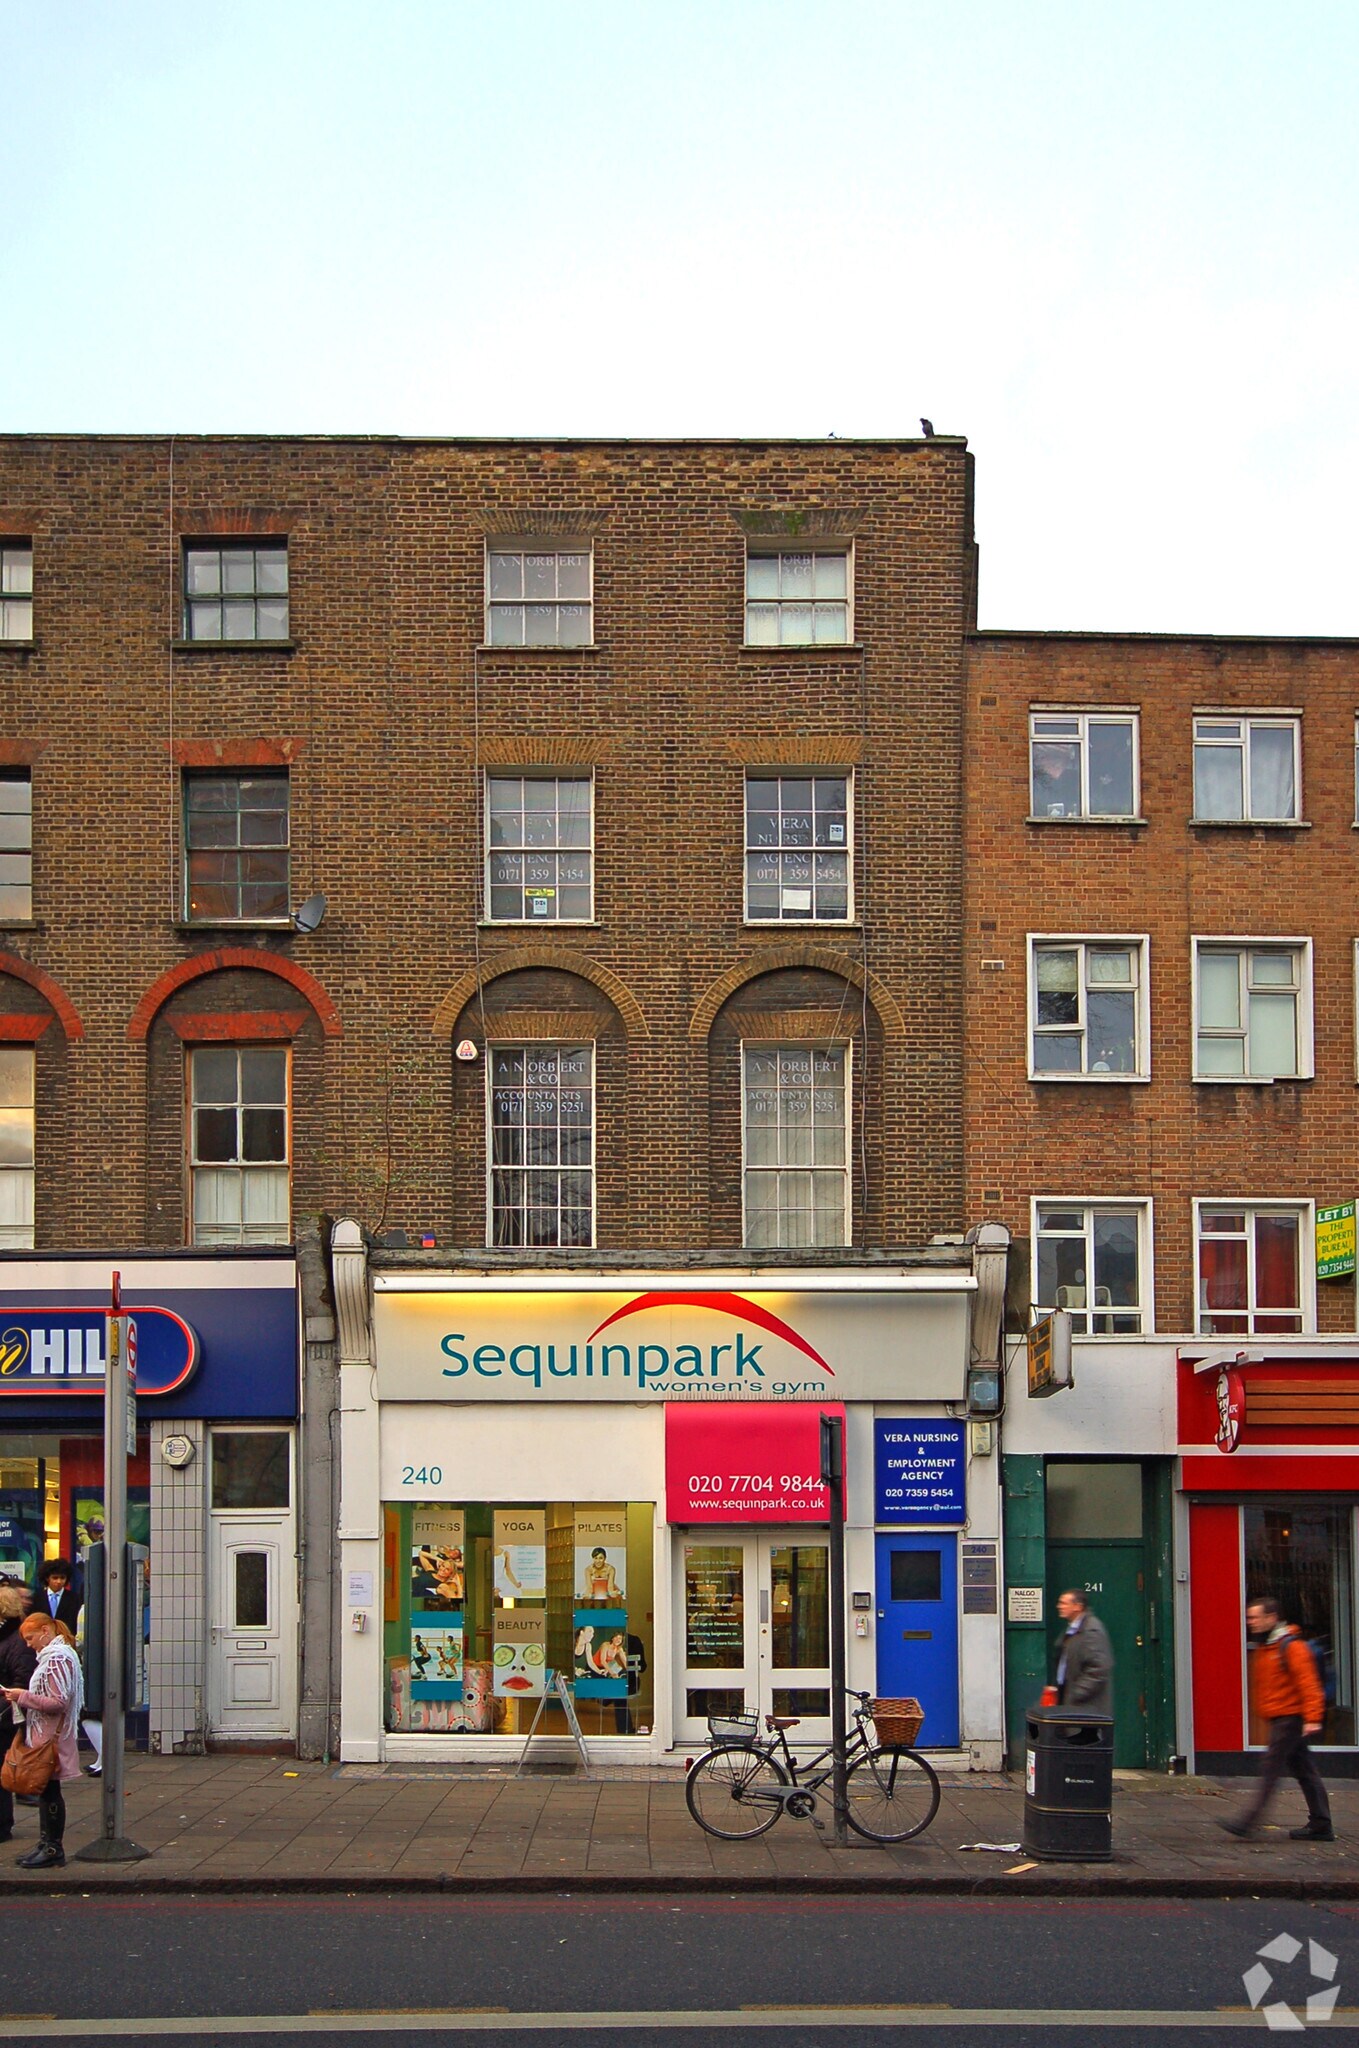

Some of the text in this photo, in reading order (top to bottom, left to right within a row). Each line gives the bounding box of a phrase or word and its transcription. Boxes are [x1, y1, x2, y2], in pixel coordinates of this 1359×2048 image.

[512, 556, 584, 566] NORBERT
[770, 818, 810, 829] VERA
[503, 854, 568, 863] AGENCY
[760, 853, 825, 863] AGENCY
[498, 869, 519, 880] 0171
[530, 869, 549, 880] 359
[757, 868, 778, 880] 0171
[790, 868, 809, 880] 359
[816, 868, 841, 880] 5454
[498, 1062, 585, 1072] A NORBERT
[752, 1061, 840, 1072] A NORBERT
[526, 1074, 558, 1084] & CO
[780, 1073, 812, 1084] & CO
[495, 1091, 581, 1100] ACCOUNTANTS
[749, 1091, 834, 1100] ACCOUNTANTS
[501, 1102, 523, 1112] 0171
[533, 1102, 553, 1112] 359
[561, 1102, 584, 1112] 5251
[755, 1101, 777, 1112] 0171
[787, 1101, 807, 1112] 359
[814, 1101, 838, 1112] 5251
[1317, 1204, 1354, 1223] LET BY
[1330, 1221, 1345, 1232] THE
[31, 1329, 106, 1374] HIL
[440, 1333, 765, 1388] Sequinpark
[650, 1380, 825, 1394] women's gym
[884, 1434, 959, 1442] VERA NURSING
[917, 1447, 925, 1455] &
[887, 1459, 956, 1468] EMPLOYMENT
[402, 1466, 442, 1485] 240
[901, 1471, 944, 1480] AGENCY
[688, 1476, 825, 1492] 020 7704 9844
[885, 1489, 953, 1497] 020 7359 5454
[689, 1498, 825, 1511] www.sequinpark.co.uk
[415, 1522, 461, 1532] FITNESS
[502, 1522, 535, 1531] YOGA
[578, 1523, 623, 1533] PILATES
[1085, 1582, 1103, 1592] 241
[497, 1621, 542, 1630] BEAUTY
